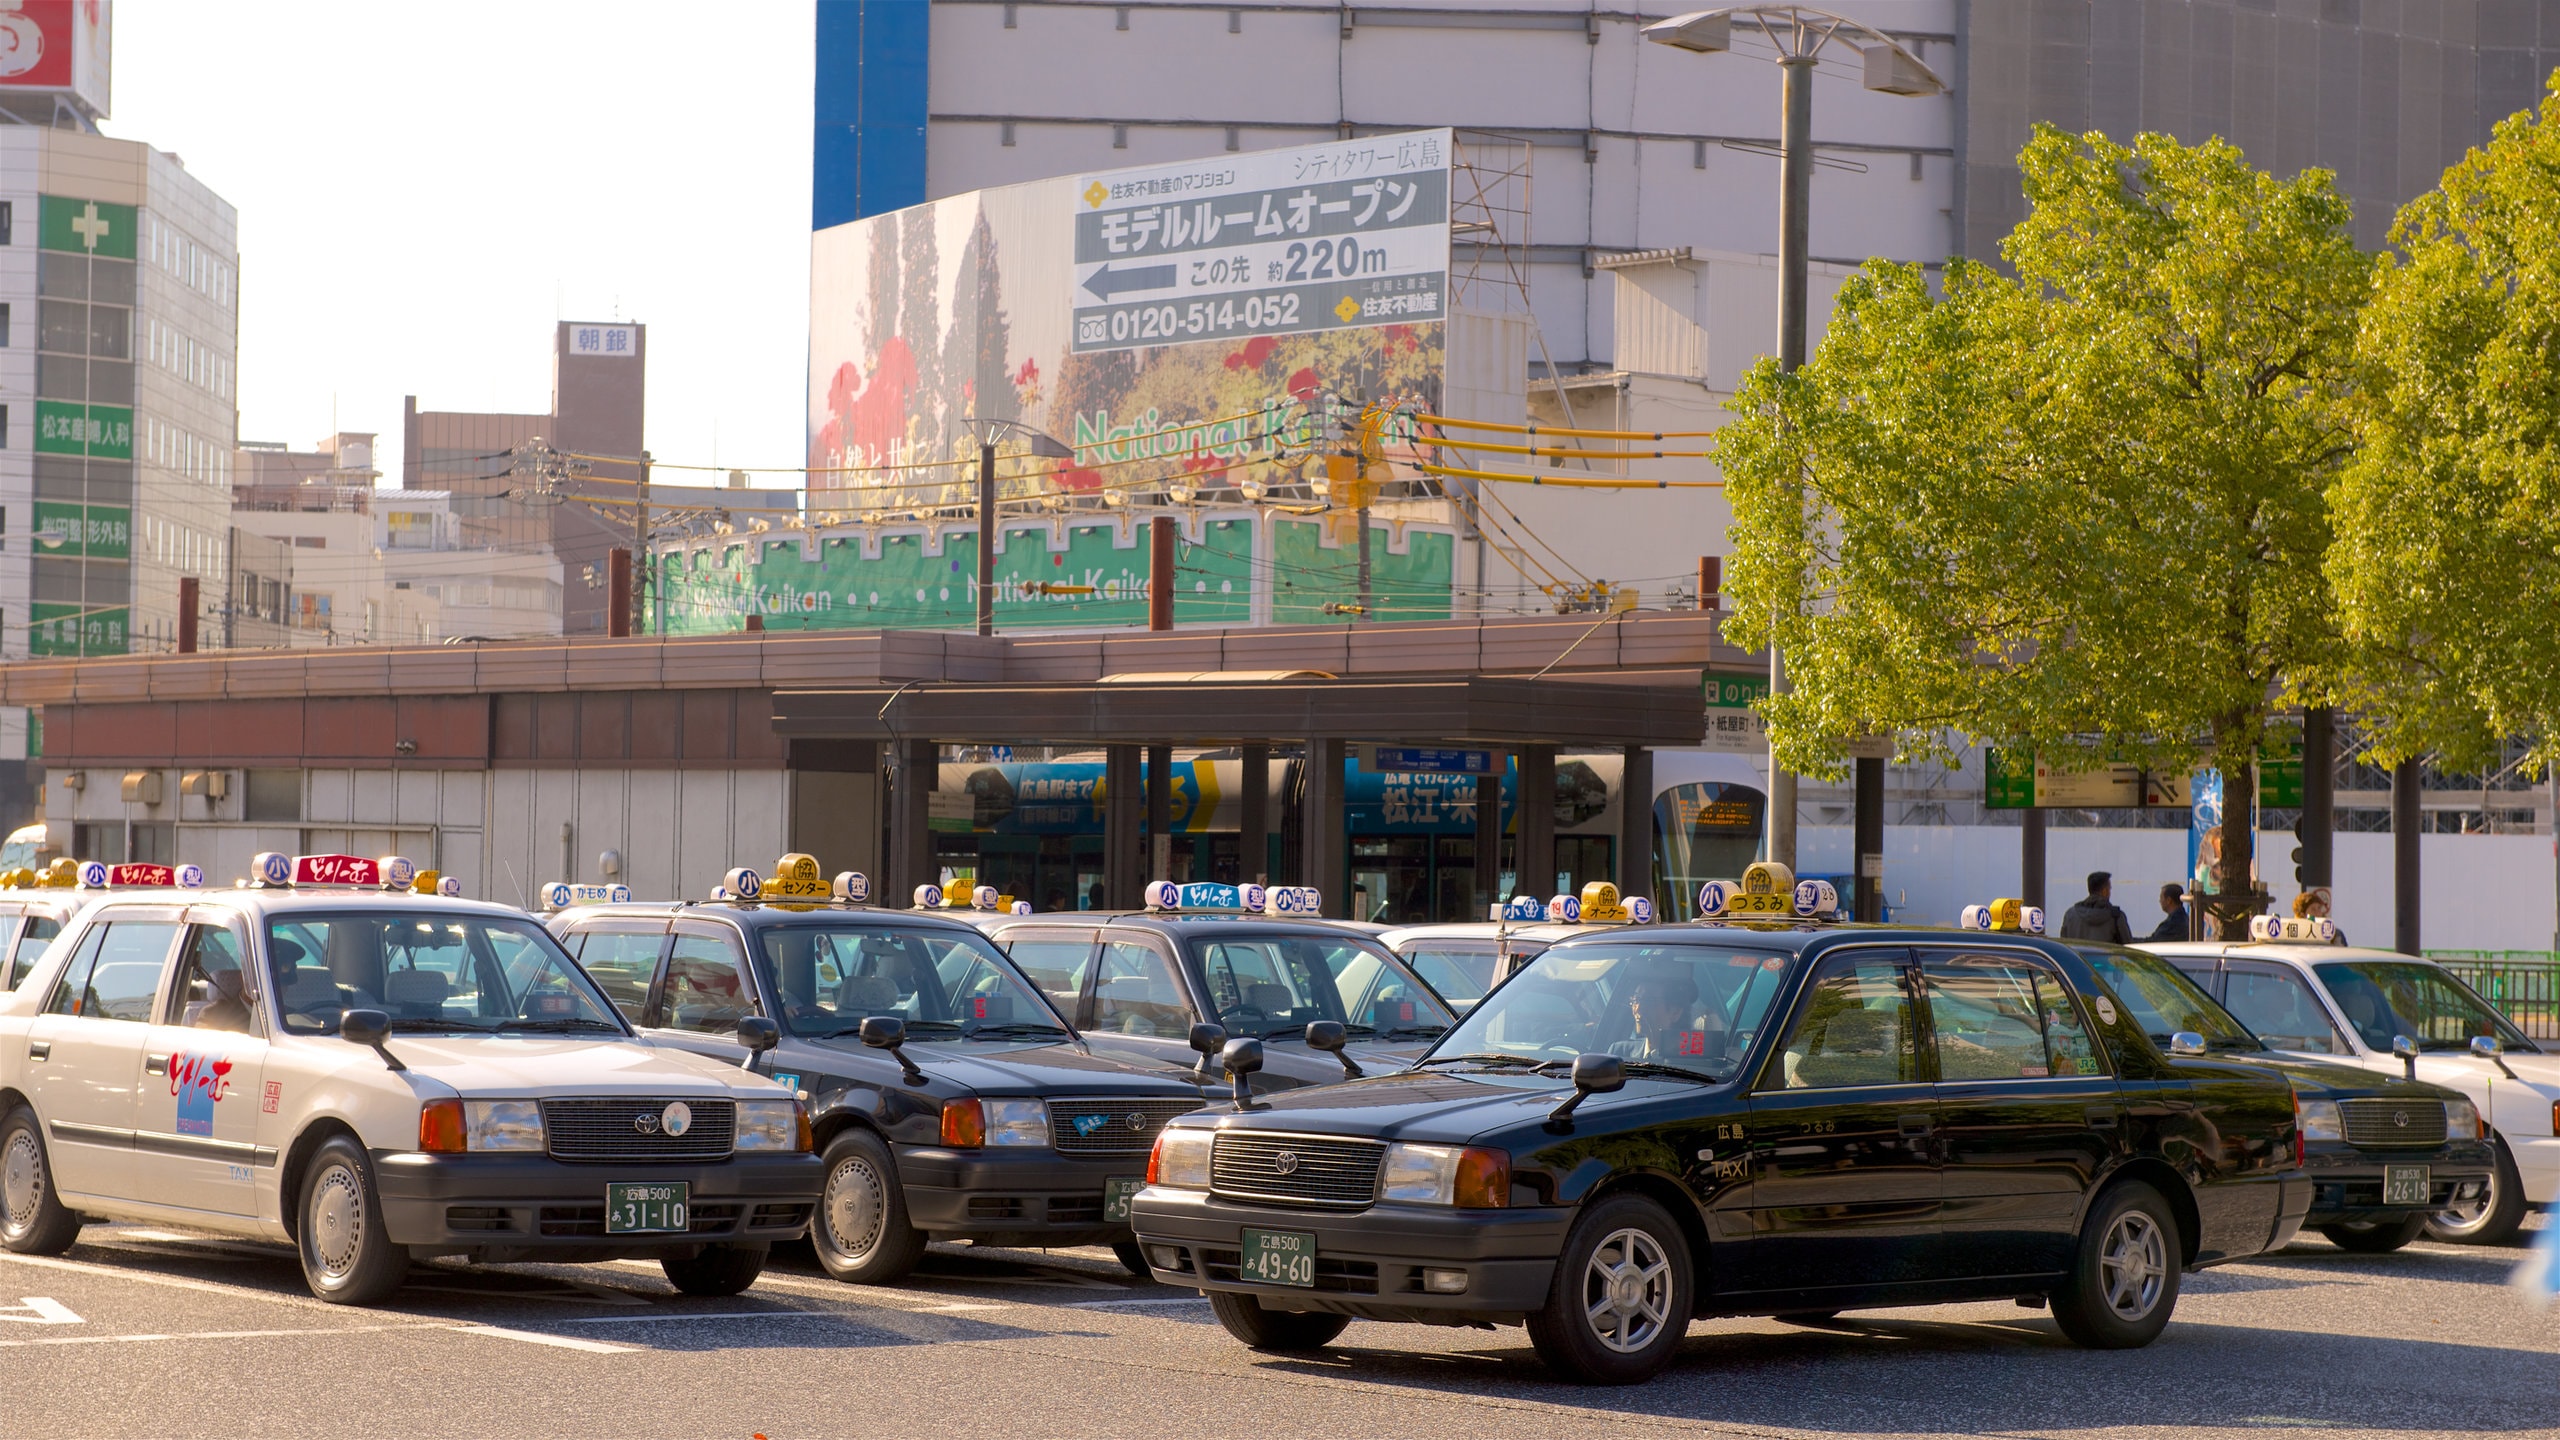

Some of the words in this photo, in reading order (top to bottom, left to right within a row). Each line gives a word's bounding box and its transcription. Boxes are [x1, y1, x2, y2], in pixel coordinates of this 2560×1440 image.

[1294, 138, 1440, 180] シティタワー広島
[1111, 170, 1236, 200] 住友不動産のマンション
[1100, 178, 1417, 253] モデルルームオープン
[1191, 256, 1250, 286] この先
[1362, 291, 1438, 317] 住友不動産
[1111, 293, 1300, 341] 0120-514-052
[578, 328, 628, 352] 朝銀
[1075, 407, 1251, 467] National
[751, 583, 832, 614] Kaikan
[1020, 779, 1094, 800] 広島駅まで
[87, 866, 105, 883] 小
[186, 869, 201, 885] 型
[268, 858, 289, 879] 小
[393, 862, 413, 883] 型
[553, 887, 572, 904] 小
[577, 887, 608, 899] かもめ
[741, 872, 759, 895] 小
[782, 881, 827, 895] センター
[851, 878, 866, 896] 型
[926, 888, 941, 903] 小
[1161, 885, 1178, 904] 小
[1251, 888, 1265, 908] 型
[1277, 890, 1292, 908] 小
[1304, 892, 1320, 907] 型
[1702, 886, 1722, 909] 小
[1734, 896, 1784, 911] つるみ
[1796, 886, 1816, 909] 型
[1821, 887, 1835, 901] 28
[1505, 904, 1521, 919] 小
[1566, 899, 1580, 917] 小
[1591, 907, 1625, 919] オーケー
[1636, 901, 1650, 918] 型
[1979, 909, 1992, 926] 小
[2268, 919, 2281, 937] 小
[2286, 922, 2317, 939] 個人
[1717, 1122, 1745, 1140] 広島
[1801, 1119, 1836, 1134] つるみ
[228, 1165, 254, 1182] TAXI
[1710, 1159, 1749, 1179] TAXI
[2394, 1181, 2427, 1201] 26-19
[624, 1202, 685, 1229] 31-10
[1246, 1256, 1256, 1271] あ
[1258, 1250, 1312, 1283] 49-60
